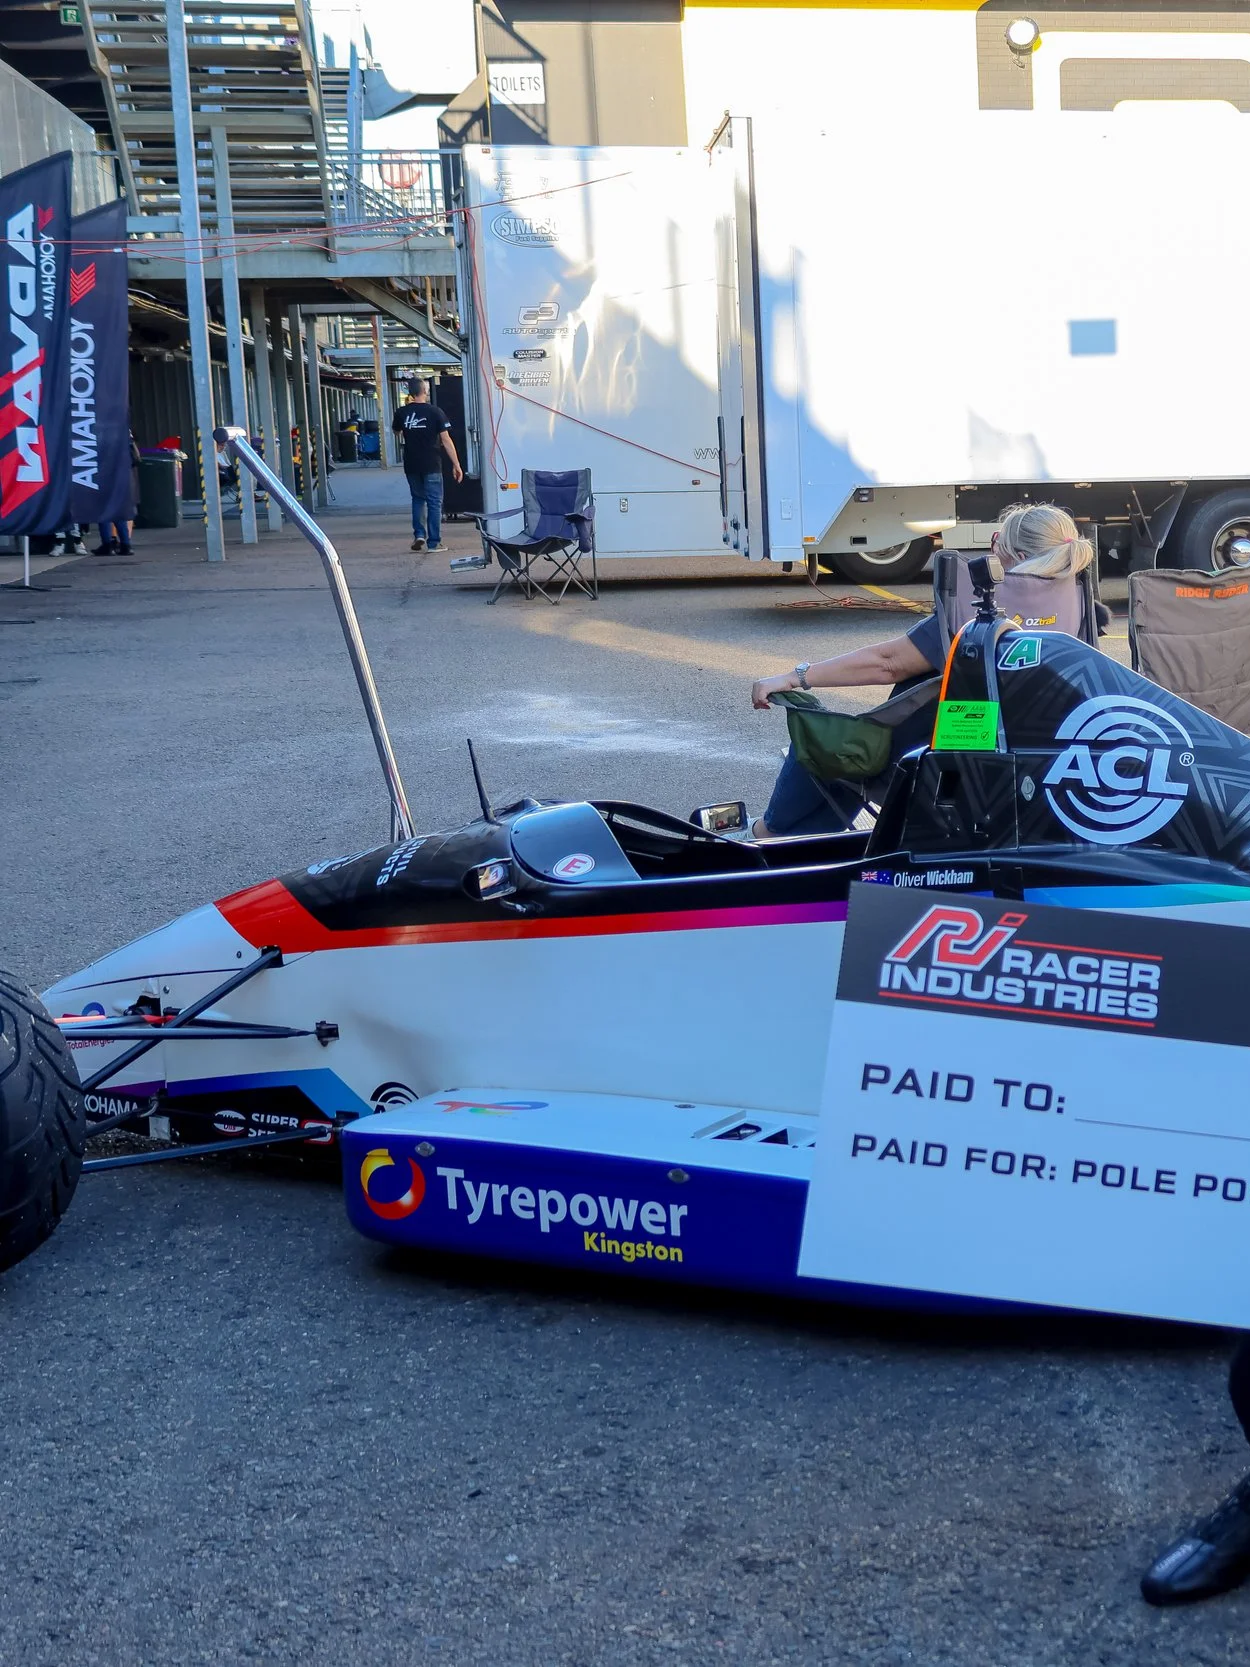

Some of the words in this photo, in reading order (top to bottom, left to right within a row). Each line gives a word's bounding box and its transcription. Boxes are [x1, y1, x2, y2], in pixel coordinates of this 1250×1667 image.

[492, 76, 541, 92] TOILETS
[1175, 586, 1211, 598] RIDGE
[1043, 744, 1189, 796] ACL
[560, 857, 588, 874] E
[893, 872, 926, 887] Oliver
[926, 869, 974, 886] Wickham
[1001, 948, 1161, 990] RACER
[879, 962, 1159, 1019] INDUSTRIES
[860, 1063, 975, 1103] PAID
[993, 1078, 1066, 1114] TO:
[851, 1134, 948, 1168] PAID
[964, 1147, 1056, 1181] FOR:
[1071, 1159, 1177, 1195] POLE
[436, 1166, 688, 1237] Tyrepower
[583, 1231, 683, 1262] Kingston
